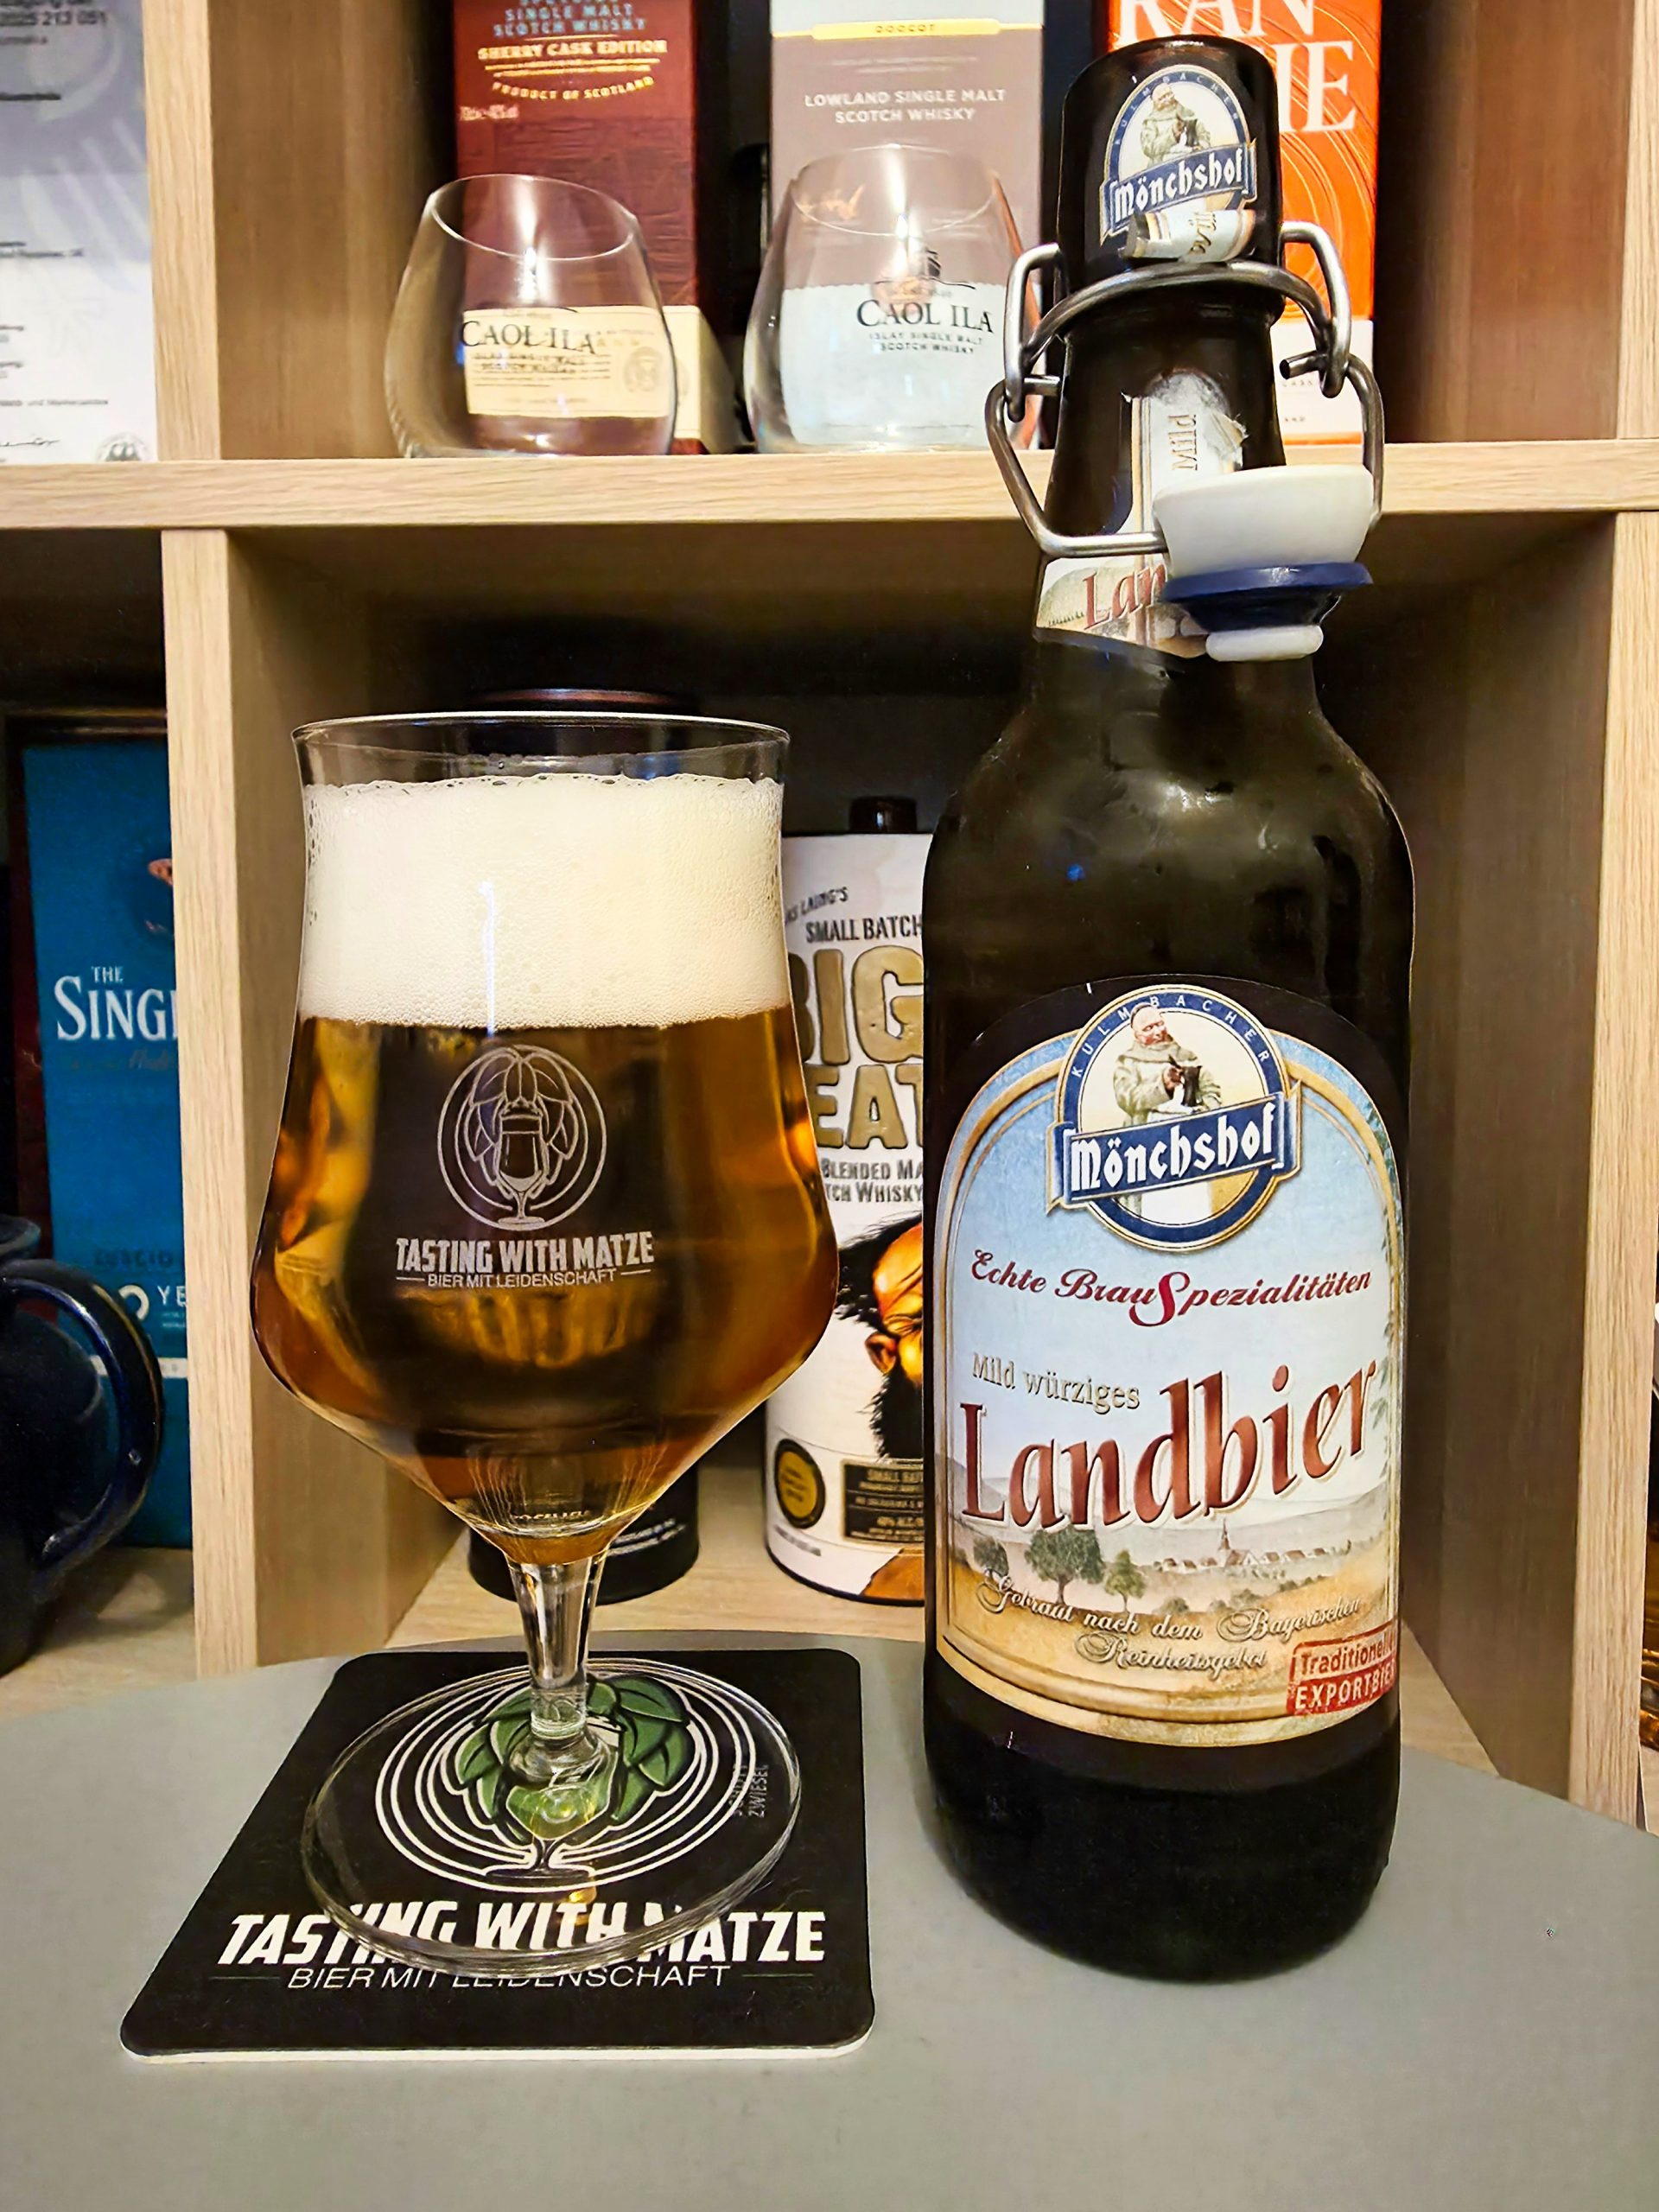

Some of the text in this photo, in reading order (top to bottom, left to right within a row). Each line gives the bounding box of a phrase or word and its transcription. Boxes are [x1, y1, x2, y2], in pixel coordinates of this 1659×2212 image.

[477, 39, 668, 60] SHERRY CASK EDITION
[492, 75, 655, 100] PRODUCT OF SCOTLAND
[804, 88, 1007, 108] LOWLAND SINGLE MALT
[1257, 40, 1356, 133] IE
[834, 107, 976, 124] SCOTCH WHISKY
[1113, 149, 1245, 225] Mönchshof
[461, 320, 596, 355] CAOL ILA
[855, 299, 995, 334] CAOL ILA
[1167, 414, 1198, 472] Mild
[1082, 563, 1167, 630] Lan
[806, 913, 923, 944] SMALL BATCH
[91, 966, 124, 983] THE
[1071, 995, 1270, 1078] KULMBACHER
[803, 1064, 924, 1149] EAT
[1071, 1102, 1276, 1192] Mönchshof
[821, 1158, 891, 1180] BLENDED
[855, 1181, 923, 1203] WHISKY
[396, 1230, 655, 1273] TASTING WITH MATZE
[970, 1249, 1047, 1293] Echte
[157, 1284, 186, 1306] YE
[428, 1268, 616, 1287] BIER MIT LEIDENSCHAFT
[972, 1352, 1141, 1415] Mild würziges
[960, 1359, 1377, 1531] Landbier
[976, 1567, 1361, 1643] Gebraut nach dem Bayerischen
[1074, 1631, 1267, 1681] Reinheitsgebot
[747, 1764, 769, 1818] ZWIESEL
[474, 1901, 627, 1951] WITH
[287, 1967, 375, 1989] BIER
